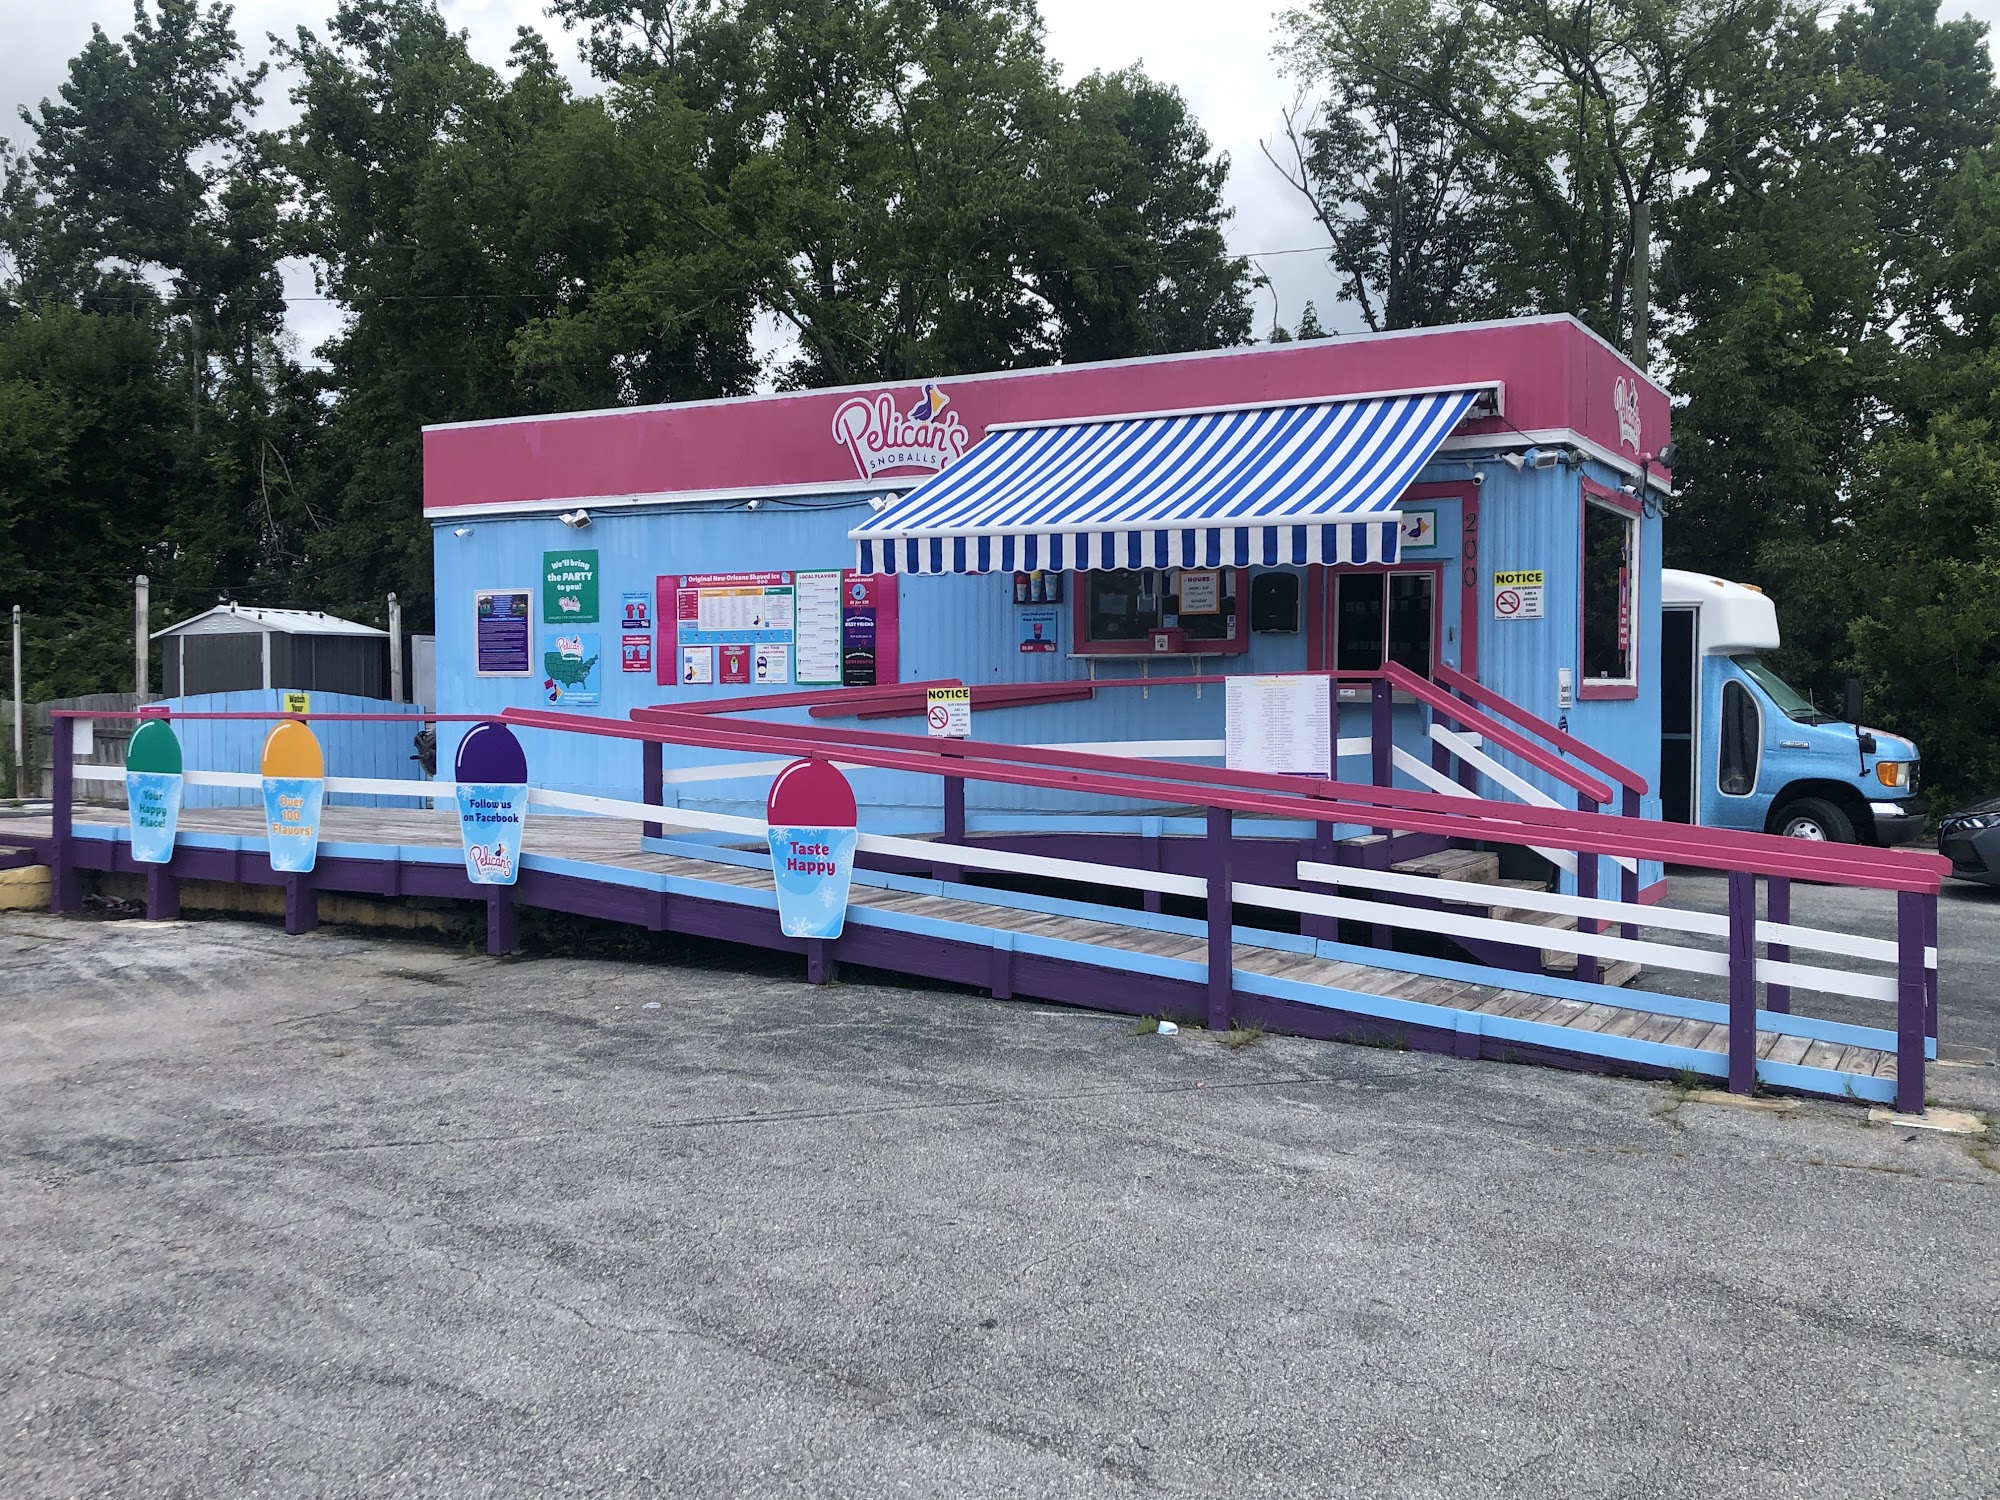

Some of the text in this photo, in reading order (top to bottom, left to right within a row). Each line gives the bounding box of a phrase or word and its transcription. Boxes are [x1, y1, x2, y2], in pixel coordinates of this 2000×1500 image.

[834, 394, 967, 479] Pelican's
[870, 453, 936, 468] SNOBALLS
[1463, 512, 1477, 588] 200
[551, 559, 590, 570] We'll bring
[547, 572, 593, 582] the PARTY
[688, 575, 712, 583] Original
[1496, 572, 1542, 584] NOTICE
[566, 583, 582, 592] you!
[289, 694, 305, 703] Watch
[928, 689, 969, 699] NOTICE
[291, 703, 303, 712] Your
[143, 790, 163, 800] Your
[280, 794, 304, 807] Over
[469, 799, 512, 809] Follow us
[139, 803, 167, 817] Happy
[282, 810, 300, 821] 100
[140, 816, 166, 828] Place!
[463, 812, 519, 823] on Facebook
[271, 822, 314, 836] Flavors!
[789, 841, 829, 855] Taste
[470, 845, 512, 877] Pelican's
[787, 858, 836, 876] Happy
